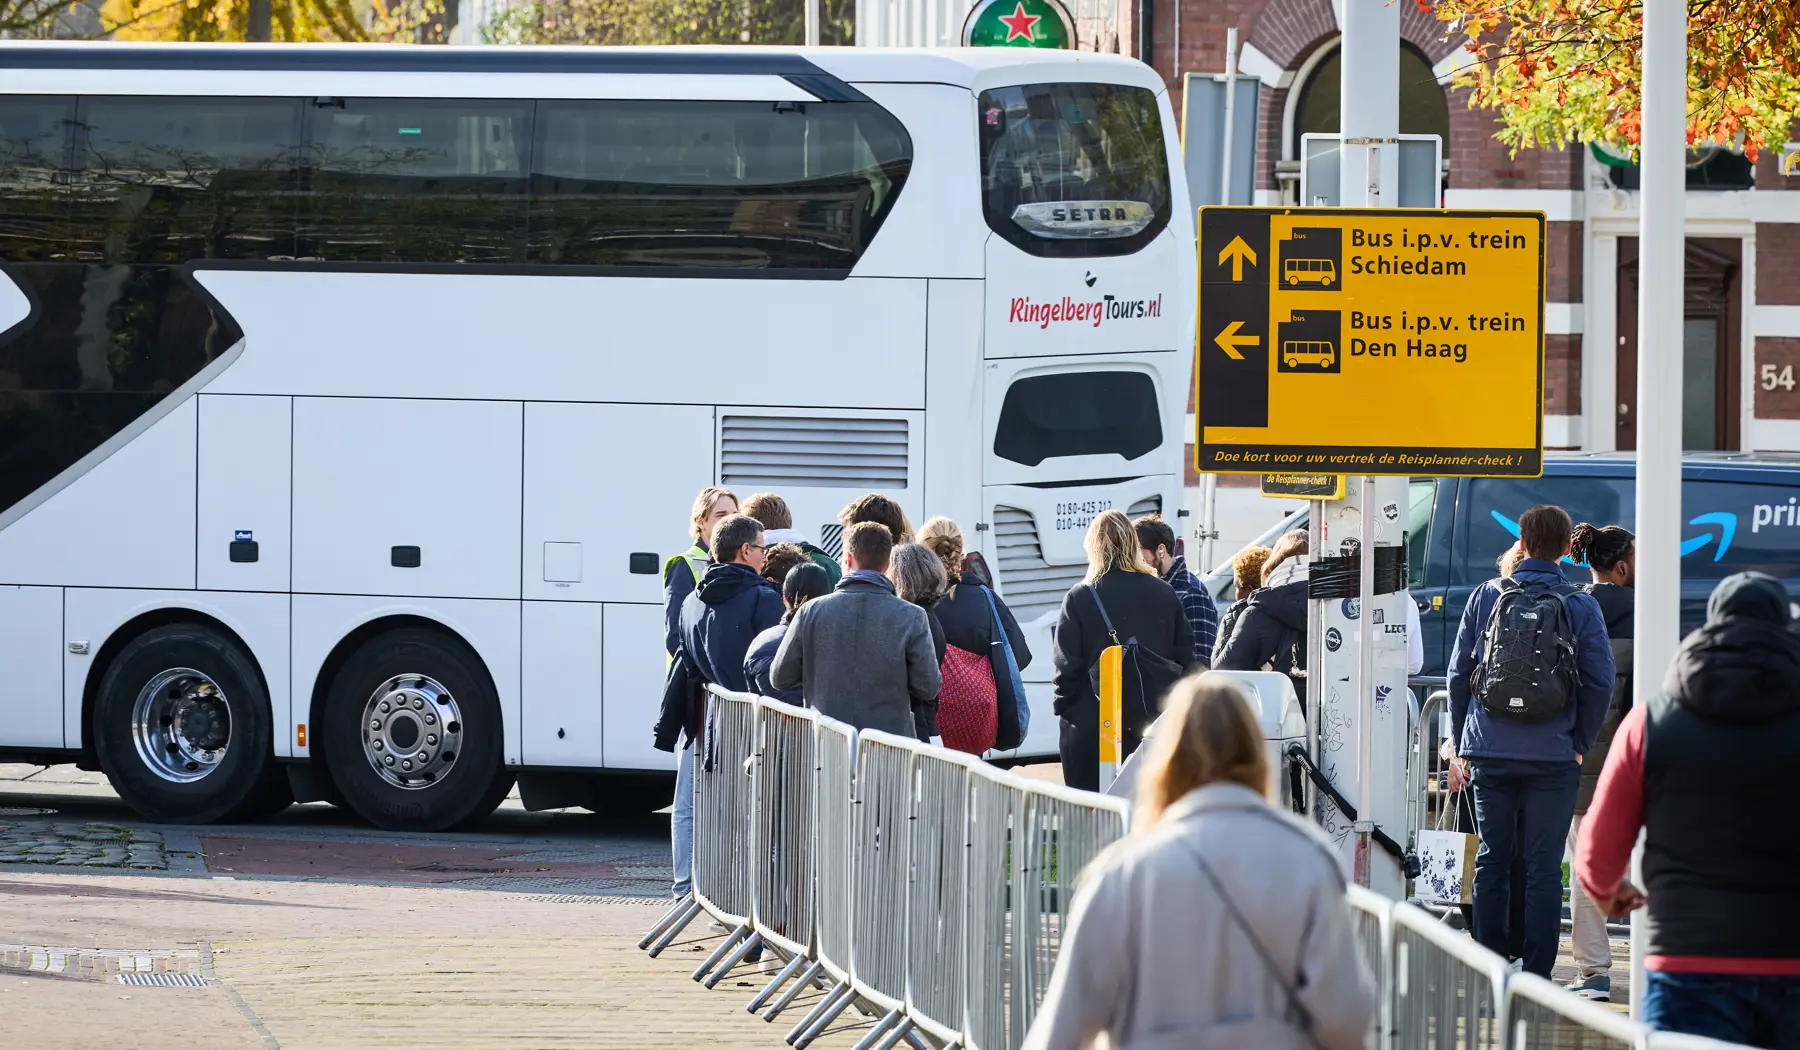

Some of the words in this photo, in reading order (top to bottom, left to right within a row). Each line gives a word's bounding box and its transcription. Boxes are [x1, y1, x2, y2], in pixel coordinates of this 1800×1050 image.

[1052, 208, 1126, 222] SETRA
[1293, 232, 1307, 240] bus
[1352, 229, 1393, 248] Bus
[1402, 229, 1460, 253] i.p.v.
[1469, 230, 1526, 249] trein
[1351, 256, 1466, 276] Schiedam
[1292, 314, 1305, 323] bus
[1351, 311, 1392, 330] Bus
[1402, 311, 1459, 335] i.p.v.
[1468, 313, 1525, 332] trein
[1350, 338, 1397, 357] Den
[1407, 339, 1468, 362] Haag
[1761, 364, 1796, 391] 54
[1214, 451, 1240, 462] Doe
[1243, 451, 1270, 462] kort
[1274, 454, 1303, 463] voor
[1306, 455, 1327, 464] uw
[1329, 453, 1375, 465] vertrek
[1379, 453, 1396, 465] de
[1397, 453, 1513, 468] Reisplanner-check
[1266, 474, 1275, 483] de
[1056, 502, 1096, 515] 0180-425
